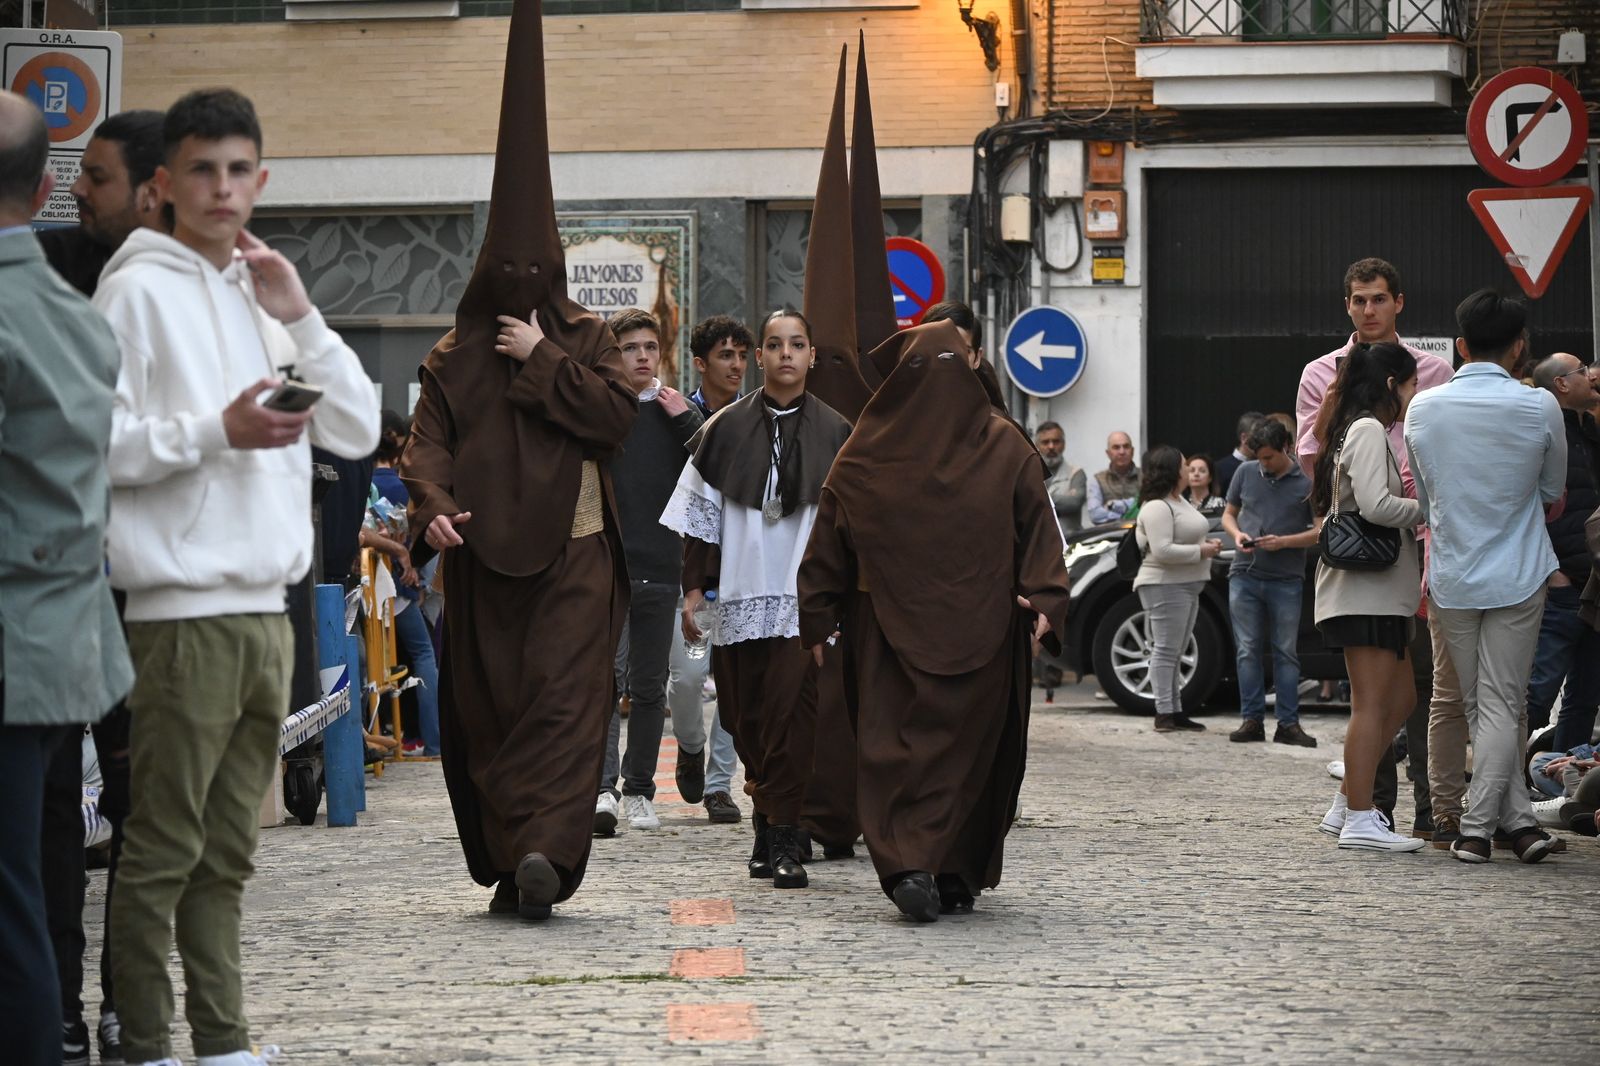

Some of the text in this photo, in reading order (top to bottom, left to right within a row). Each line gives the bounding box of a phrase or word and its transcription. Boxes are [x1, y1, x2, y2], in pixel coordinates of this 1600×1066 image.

[39, 33, 77, 44] O.R.A.
[46, 83, 65, 108] P
[568, 264, 644, 284] JAMONES
[577, 287, 638, 307] QUESOS
